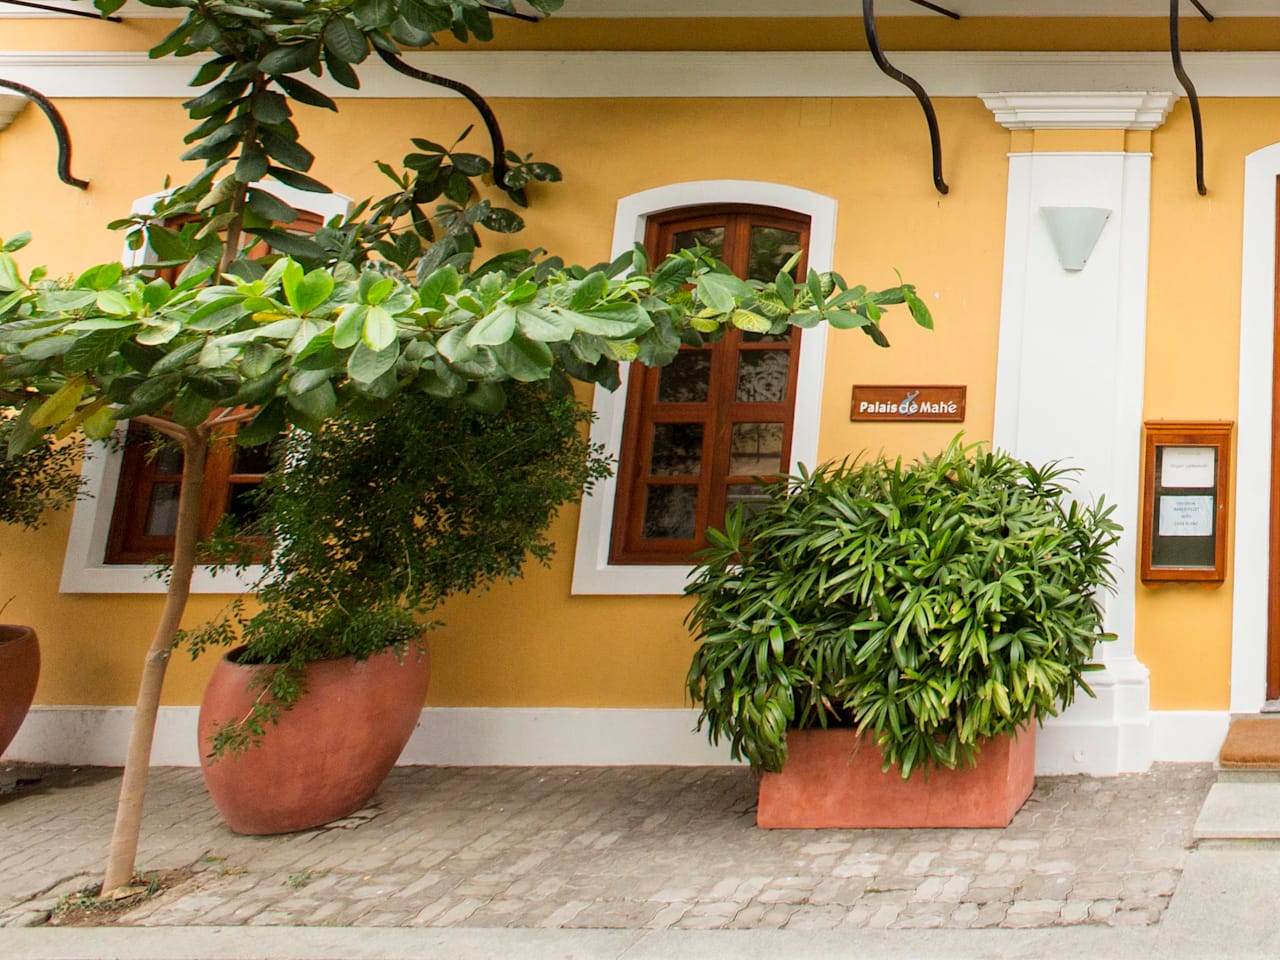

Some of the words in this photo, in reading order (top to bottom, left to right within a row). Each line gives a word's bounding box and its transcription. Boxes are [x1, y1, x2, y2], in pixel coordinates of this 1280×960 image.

[859, 400, 898, 414] Palais
[898, 401, 919, 414] de
[919, 400, 957, 414] Mahé
